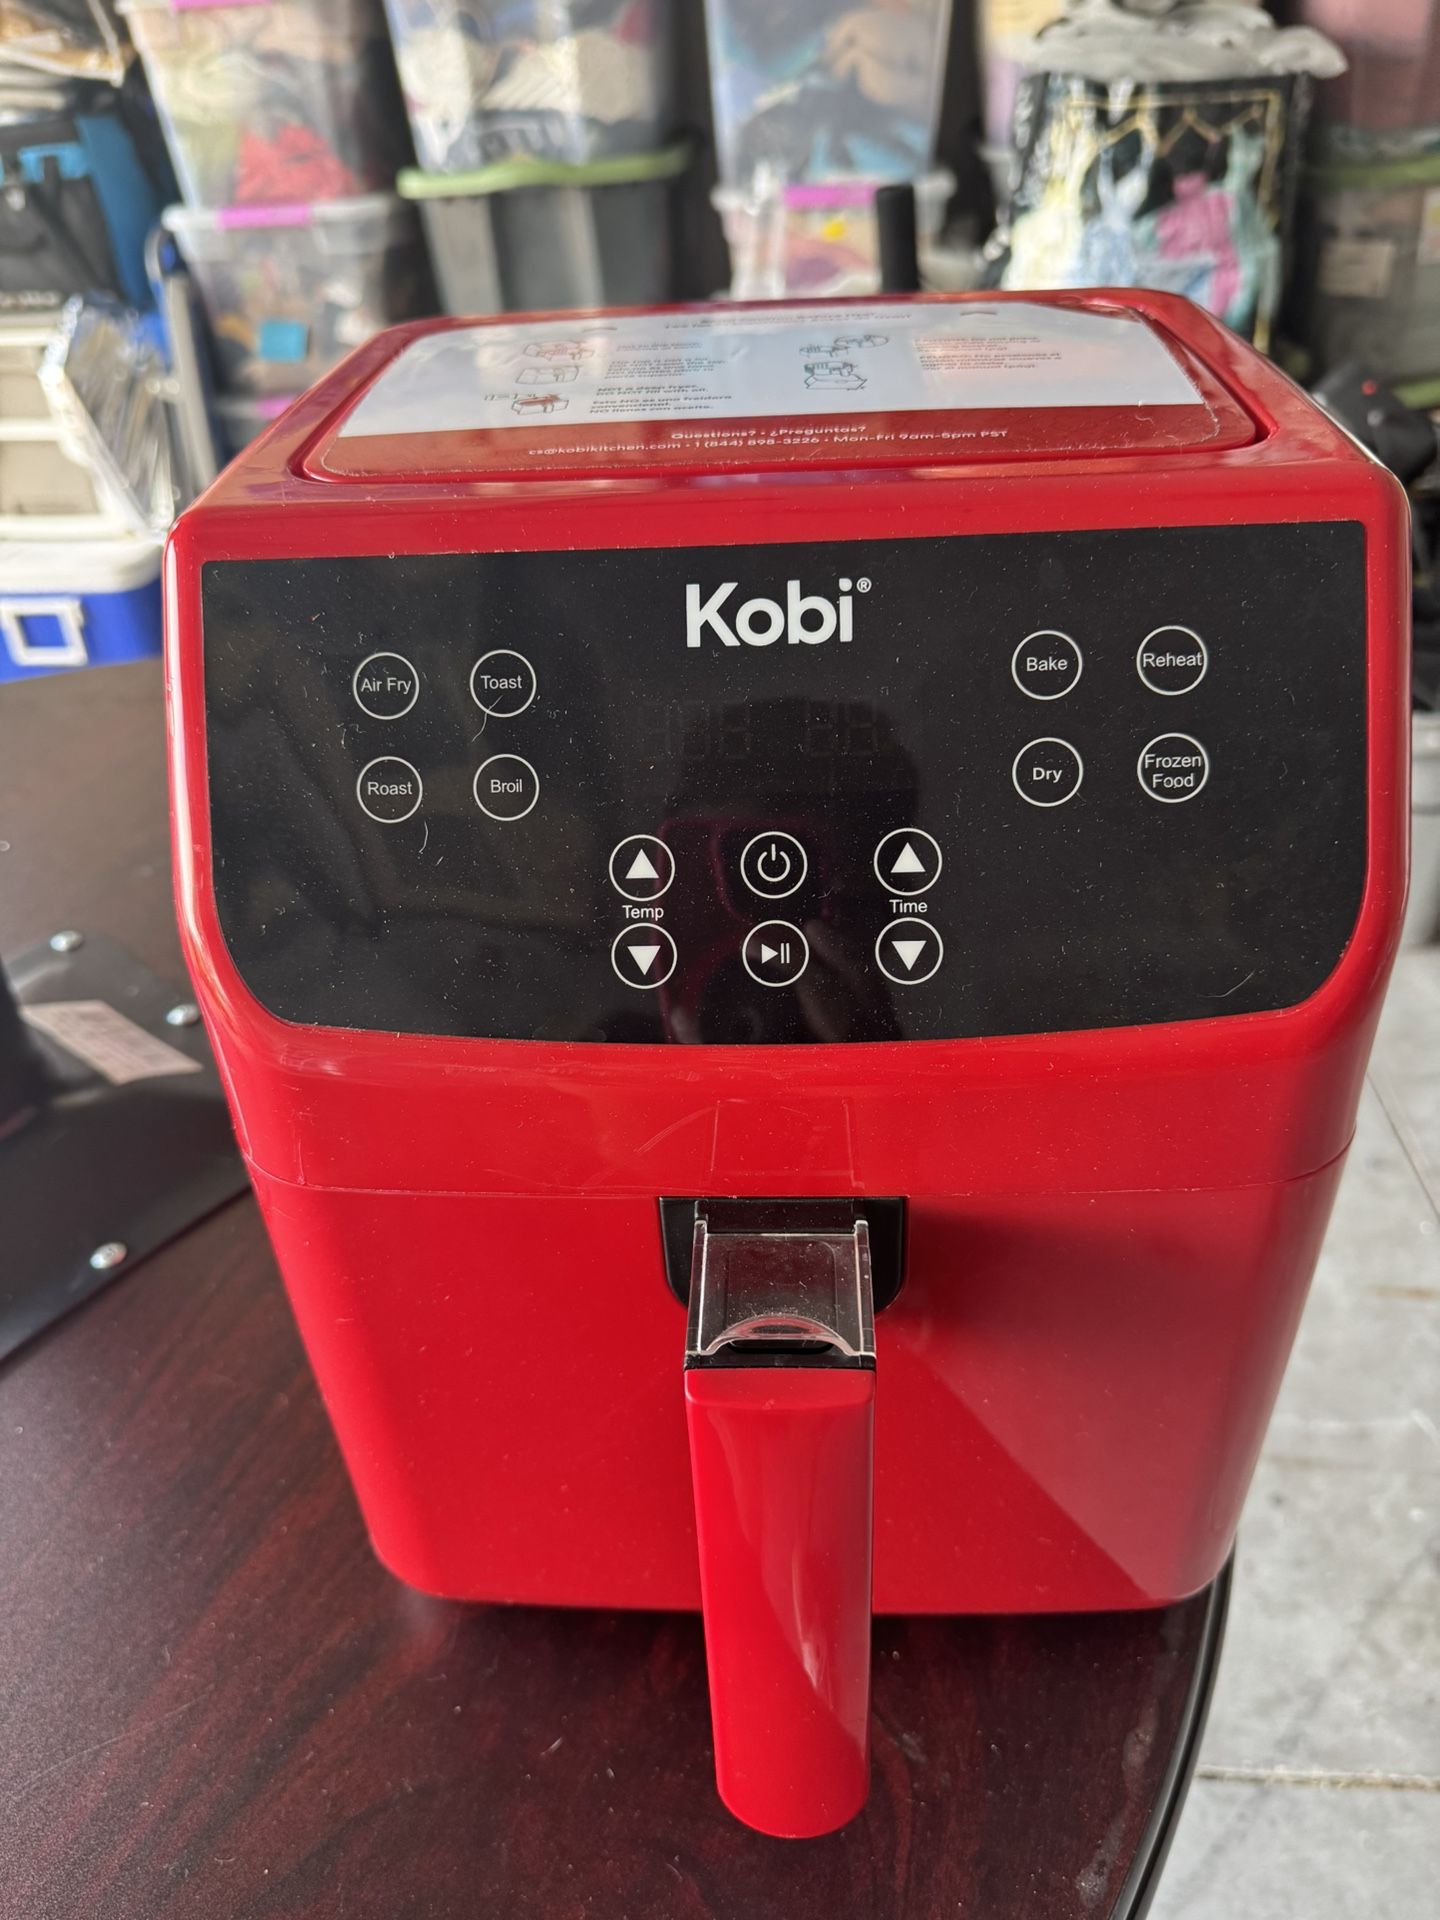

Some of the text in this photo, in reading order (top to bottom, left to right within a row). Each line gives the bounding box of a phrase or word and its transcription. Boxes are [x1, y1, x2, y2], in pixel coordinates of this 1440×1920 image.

[671, 425, 866, 440] Questions? ¿Preguntas?
[528, 441, 681, 455] cs@kobikitchen.com
[704, 439, 744, 449] (844)
[833, 433, 895, 443] Mon-Fri
[981, 430, 1008, 439] PST
[1026, 656, 1068, 672] Bake
[1142, 652, 1203, 668] Reheat
[360, 677, 412, 695] Air Fry
[480, 675, 523, 690] Toast
[1144, 753, 1202, 769] Frozen
[1032, 767, 1063, 784] Dry
[1152, 773, 1194, 788] Food
[367, 781, 413, 796] Roast
[490, 778, 523, 794] Broil
[621, 904, 665, 921] Temp
[888, 899, 928, 914] Time
